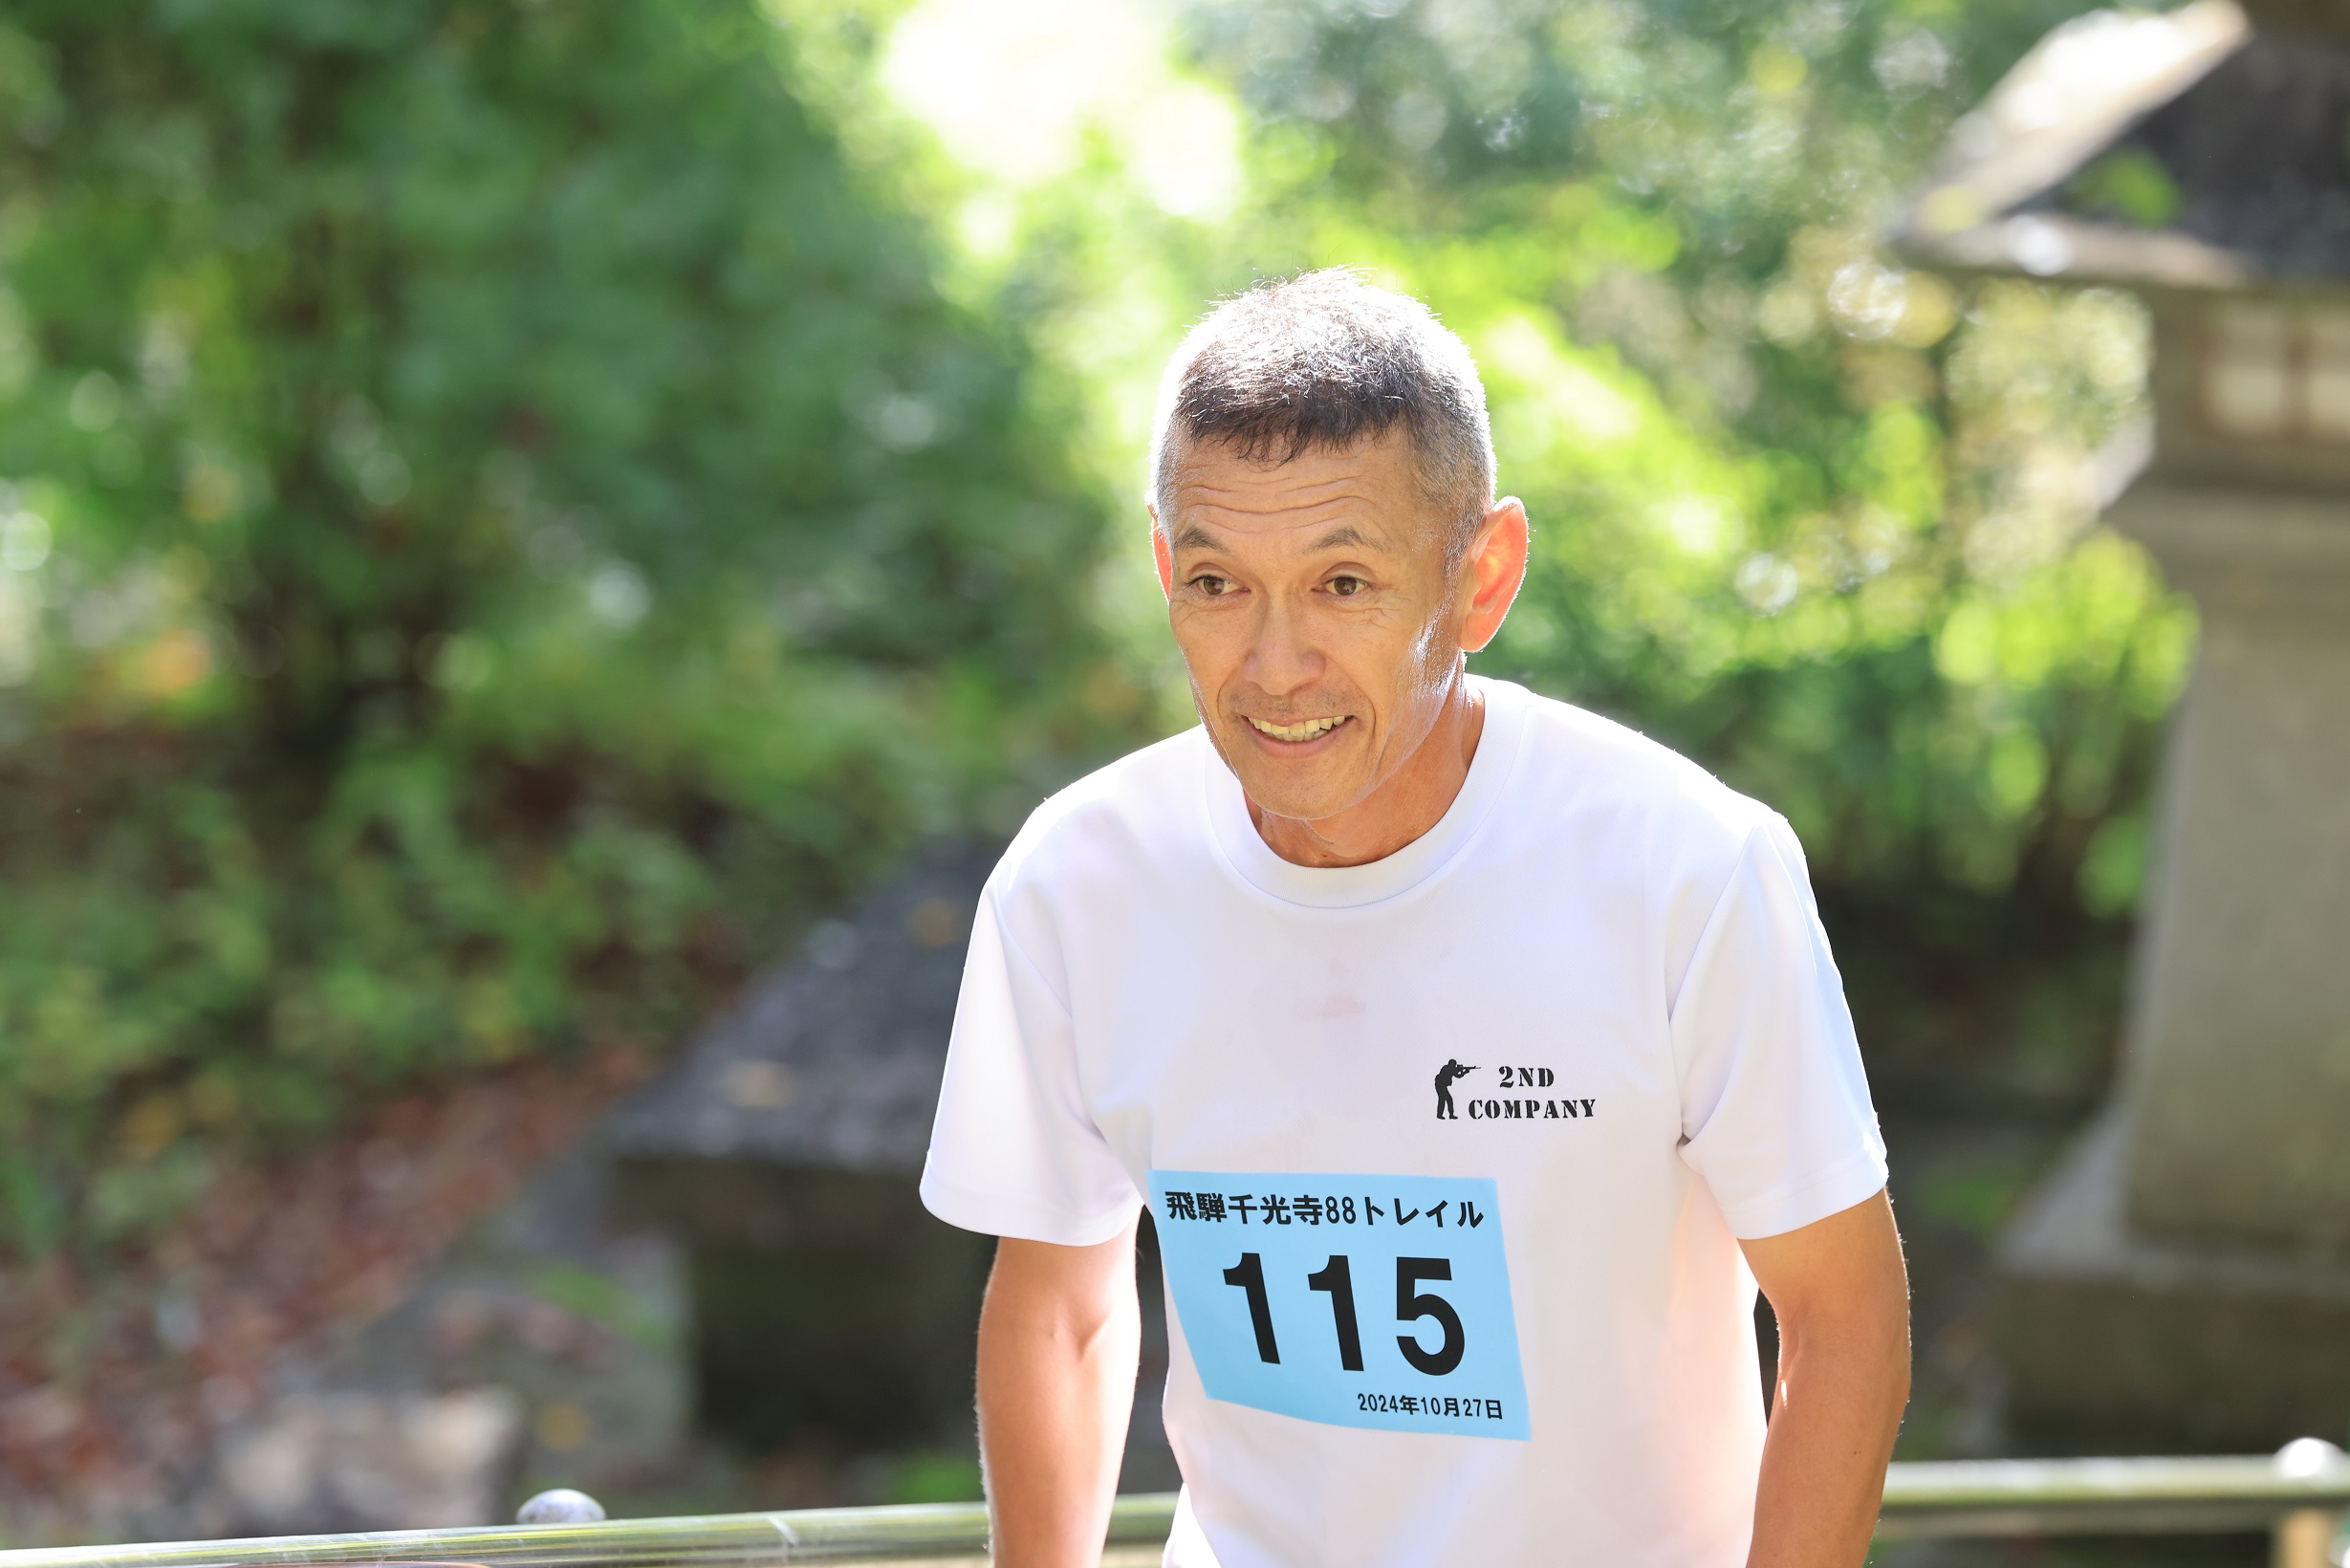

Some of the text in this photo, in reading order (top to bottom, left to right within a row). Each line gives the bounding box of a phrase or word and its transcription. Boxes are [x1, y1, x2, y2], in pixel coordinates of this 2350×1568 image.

[1498, 1065, 1555, 1088] 2ND
[1468, 1099, 1596, 1120] COMPANY
[1164, 1191, 1485, 1229] 飛騨千光寺88トレイル
[1223, 1252, 1466, 1377] 115
[1358, 1393, 1503, 1420] 2024年10月27日
